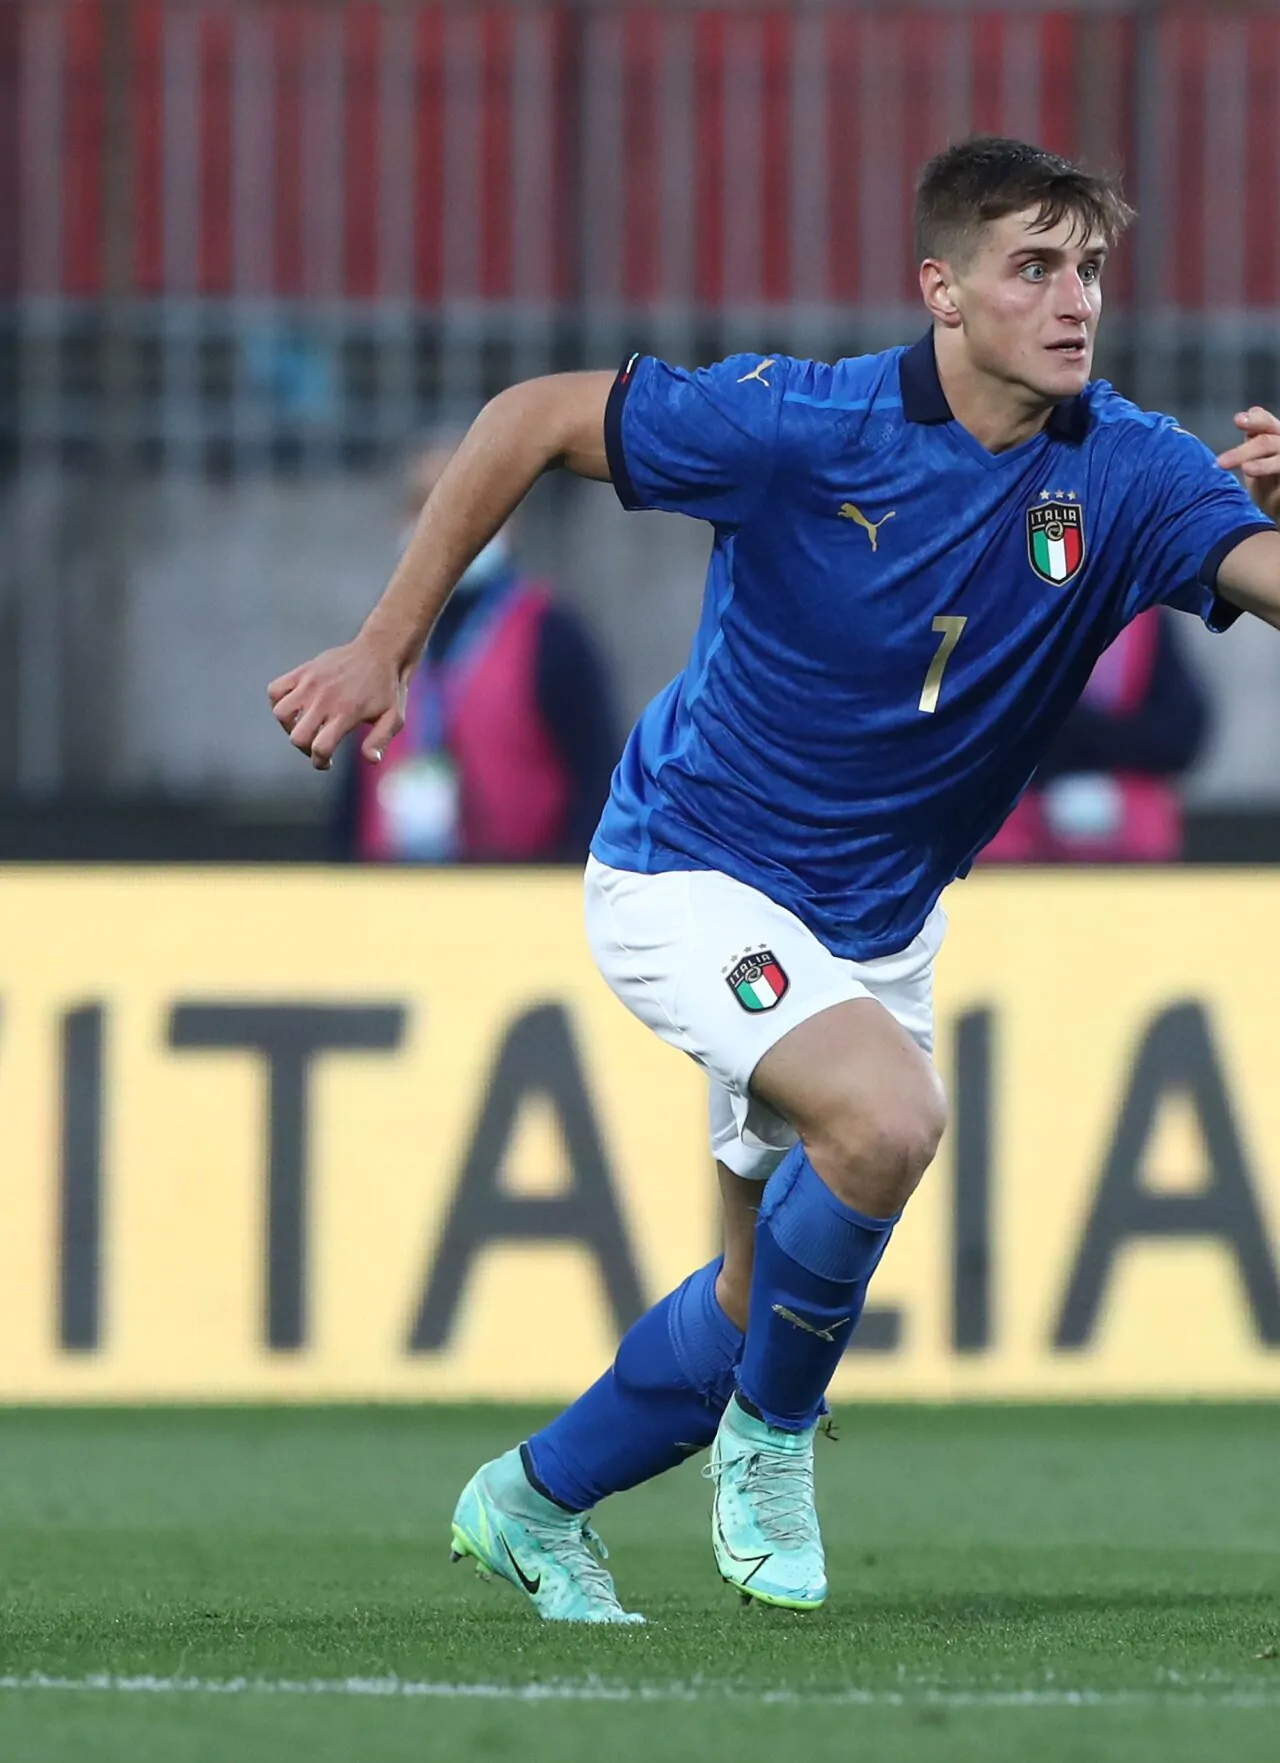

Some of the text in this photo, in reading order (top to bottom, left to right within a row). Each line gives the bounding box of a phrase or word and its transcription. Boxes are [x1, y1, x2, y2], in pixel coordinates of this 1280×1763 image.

[1031, 509, 1077, 524] ITALIA
[918, 615, 968, 713] 7
[729, 953, 771, 985] ITALIA
